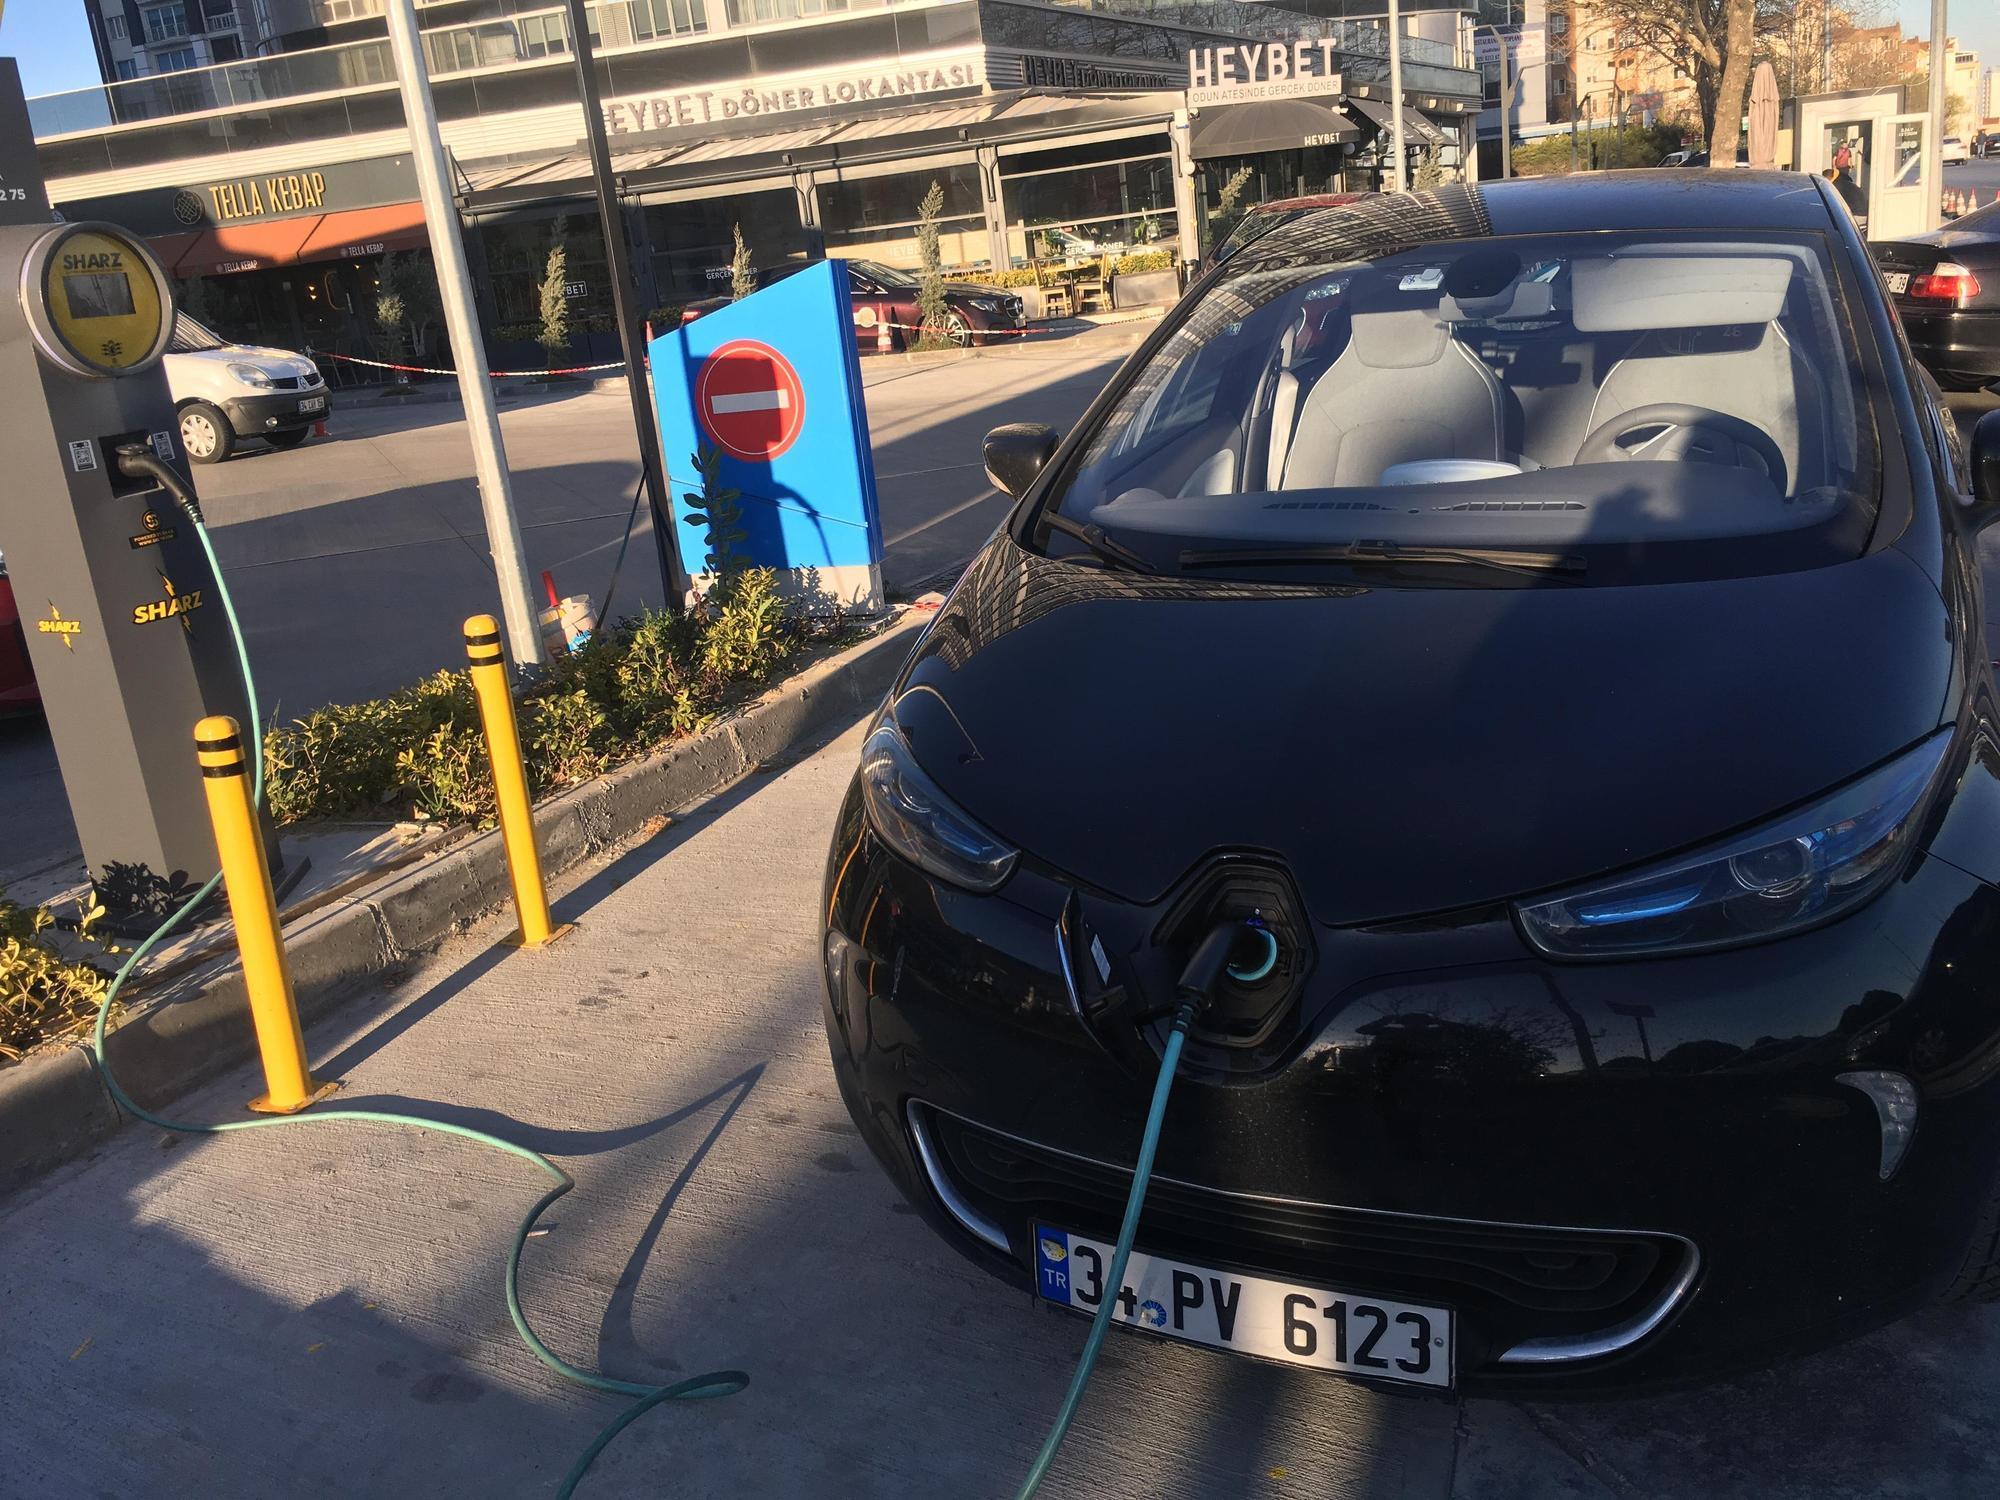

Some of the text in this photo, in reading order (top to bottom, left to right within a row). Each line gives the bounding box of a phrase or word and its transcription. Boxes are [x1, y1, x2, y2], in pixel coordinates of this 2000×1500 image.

[1189, 38, 1337, 88] HEYBET
[604, 63, 974, 134] EYBET DÖNER LOKANTASI
[1192, 91, 1219, 103] ODUN
[1307, 79, 1338, 92] DÖNER
[1304, 132, 1340, 146] HEYBET
[9, 188, 26, 201] 75
[208, 171, 326, 220] TELLA KEBAP
[348, 243, 384, 257] TELLA KEBAP
[63, 252, 123, 270] SHARZ
[223, 260, 258, 272] TELLA KEBAP
[566, 284, 585, 295] BET
[1897, 276, 1907, 290] 39
[133, 591, 203, 625] SHARZ
[38, 620, 81, 634] SHARZ
[1044, 1268, 1067, 1290] TR
[1172, 1269, 1242, 1342] PV
[1284, 1293, 1431, 1374] 6123
